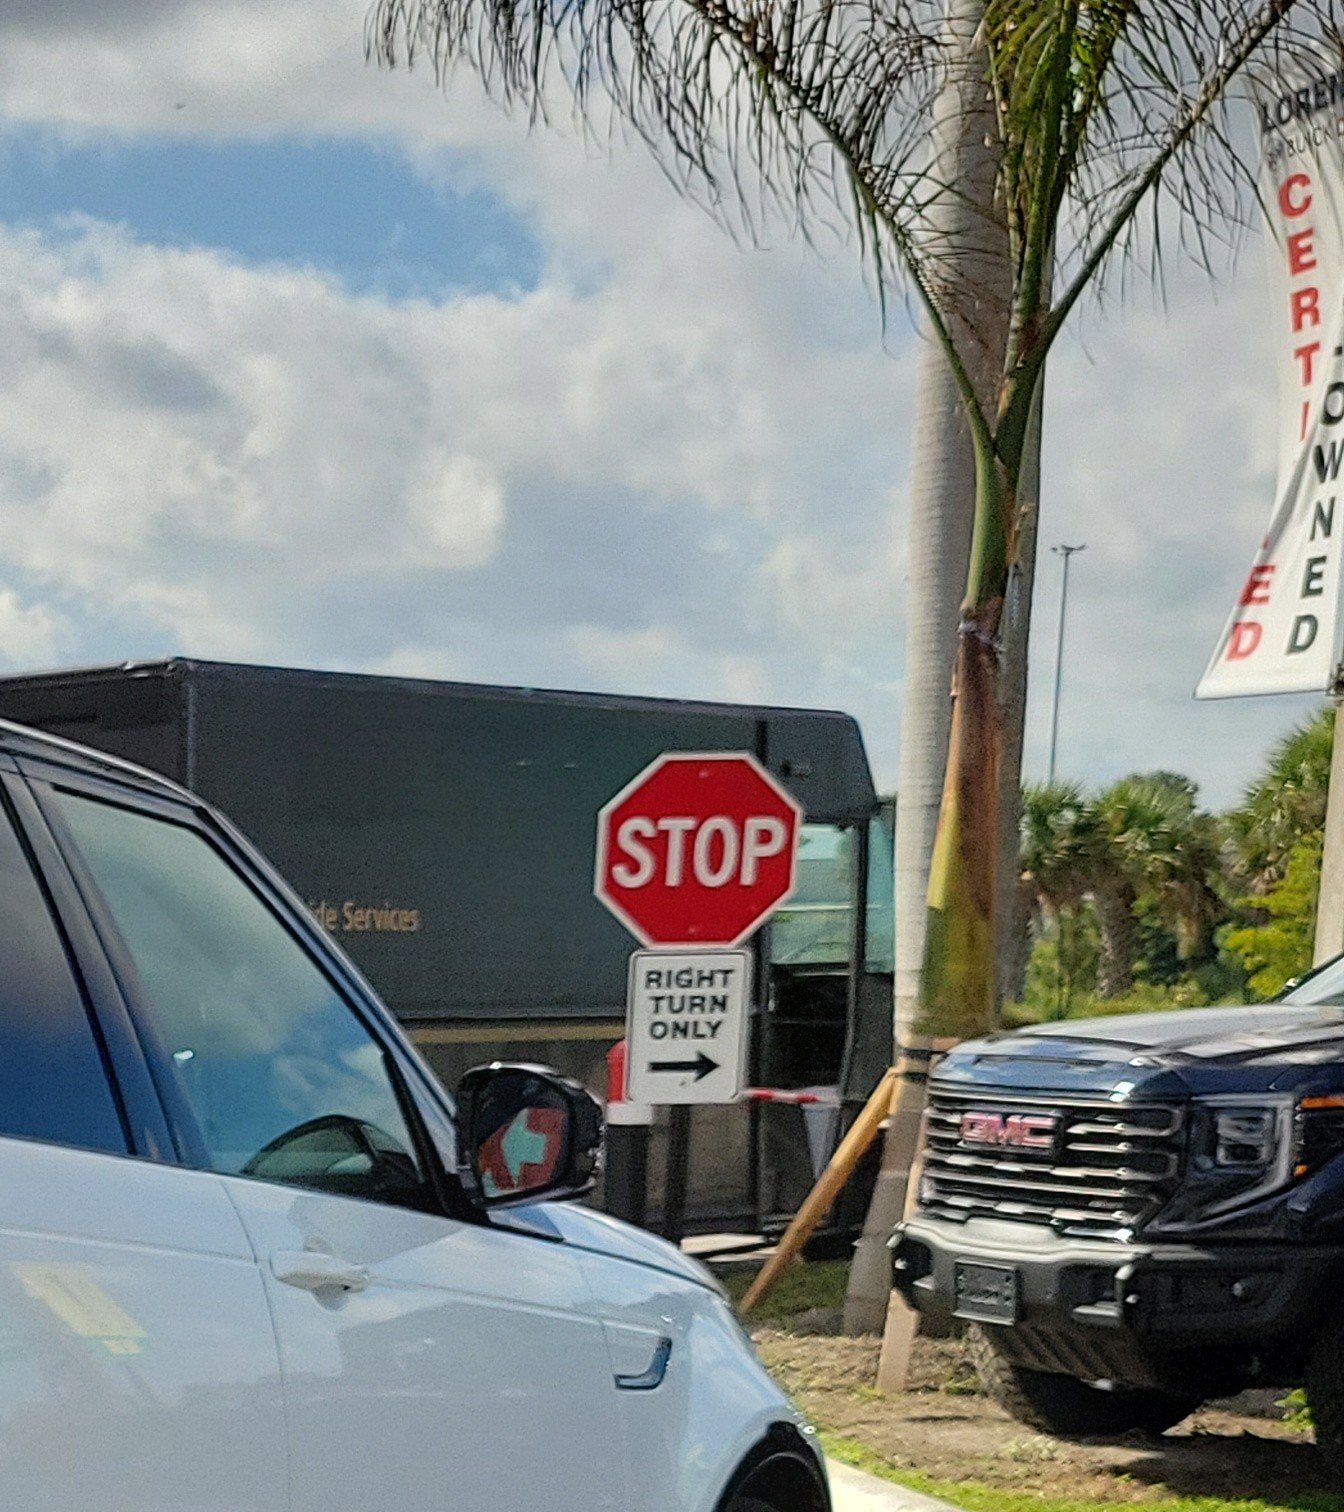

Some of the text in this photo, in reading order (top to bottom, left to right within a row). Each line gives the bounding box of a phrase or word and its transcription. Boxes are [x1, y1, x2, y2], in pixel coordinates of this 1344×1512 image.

[1226, 171, 1320, 661] CERTIED
[613, 817, 787, 888] STOP
[343, 901, 420, 931] Services
[645, 968, 735, 990] RIGHT
[650, 994, 728, 1014] TURN
[650, 1020, 723, 1040] ONLY
[959, 1111, 1055, 1148] GMC
